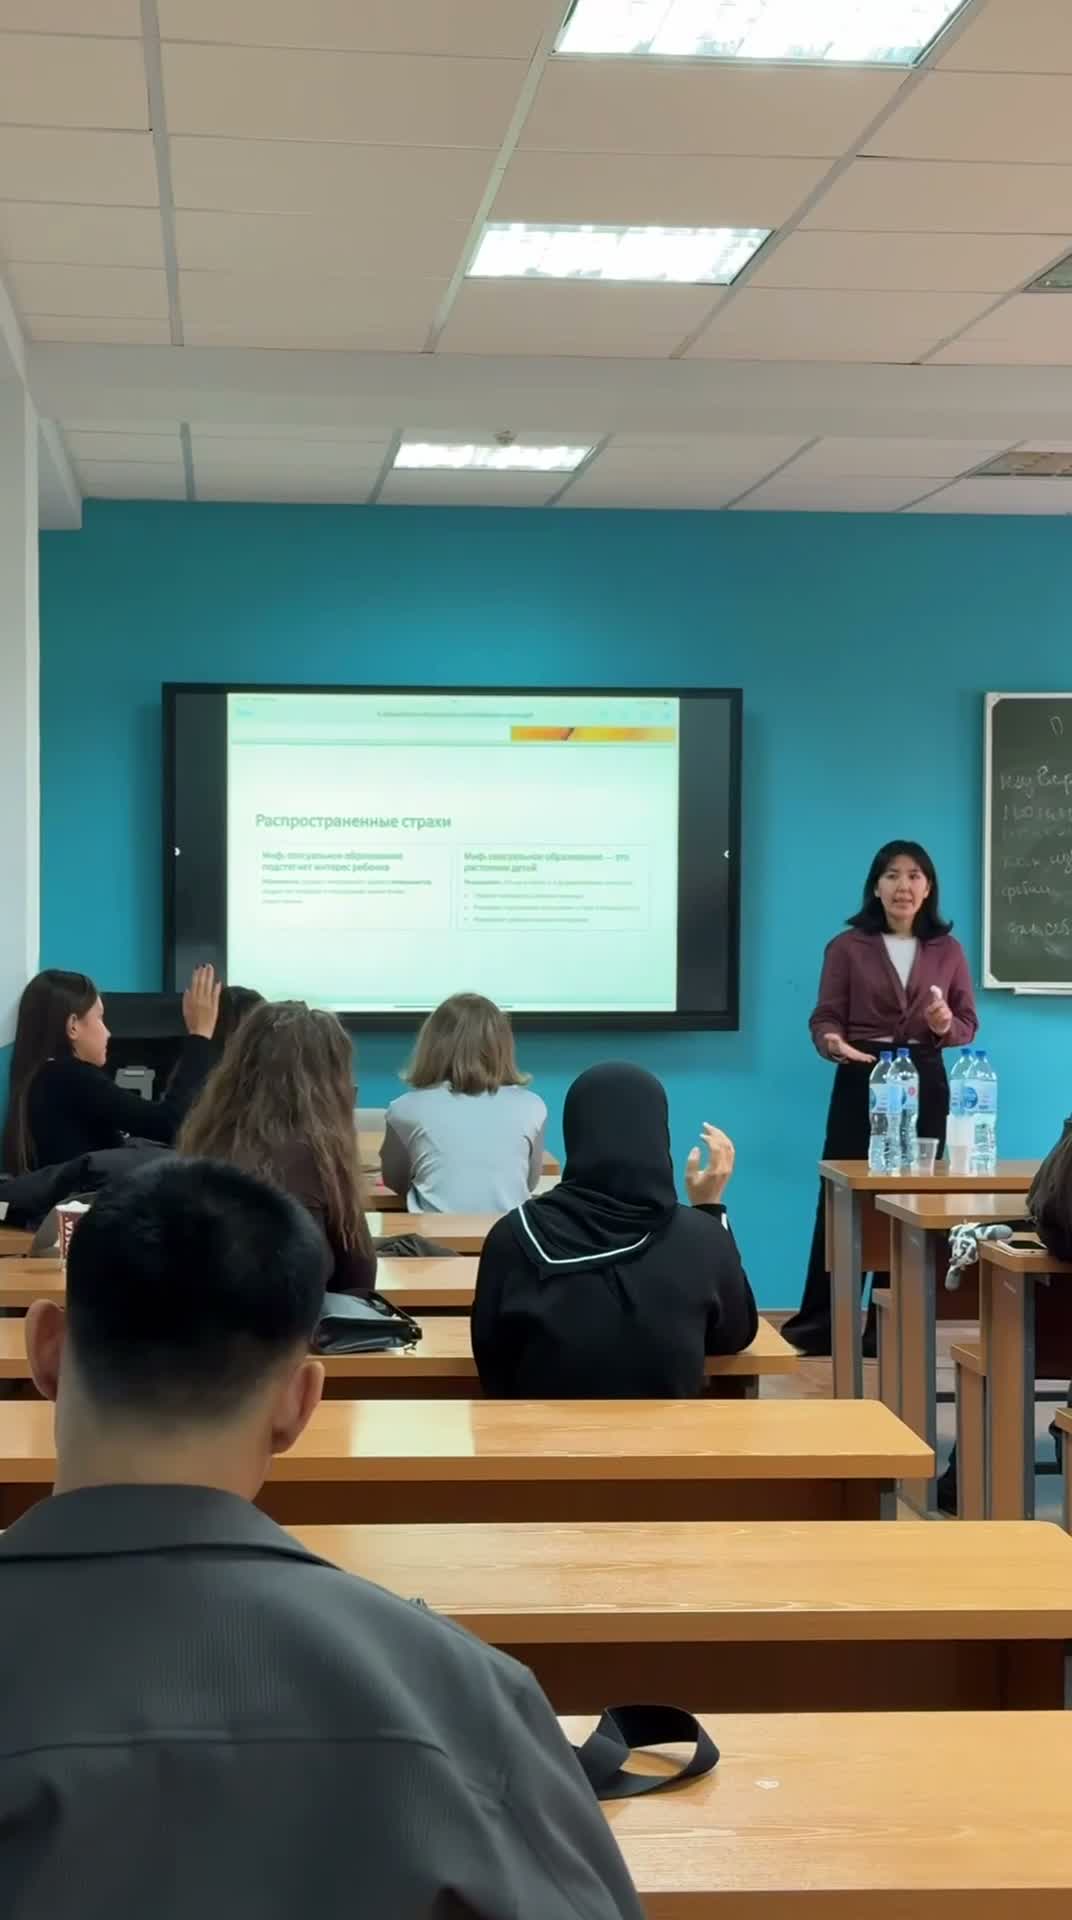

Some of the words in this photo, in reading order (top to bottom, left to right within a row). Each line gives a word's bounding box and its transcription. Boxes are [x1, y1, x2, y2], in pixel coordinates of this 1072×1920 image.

[255, 813, 399, 830] Распространенные
[400, 815, 452, 831] страхи
[314, 863, 351, 872] интерес
